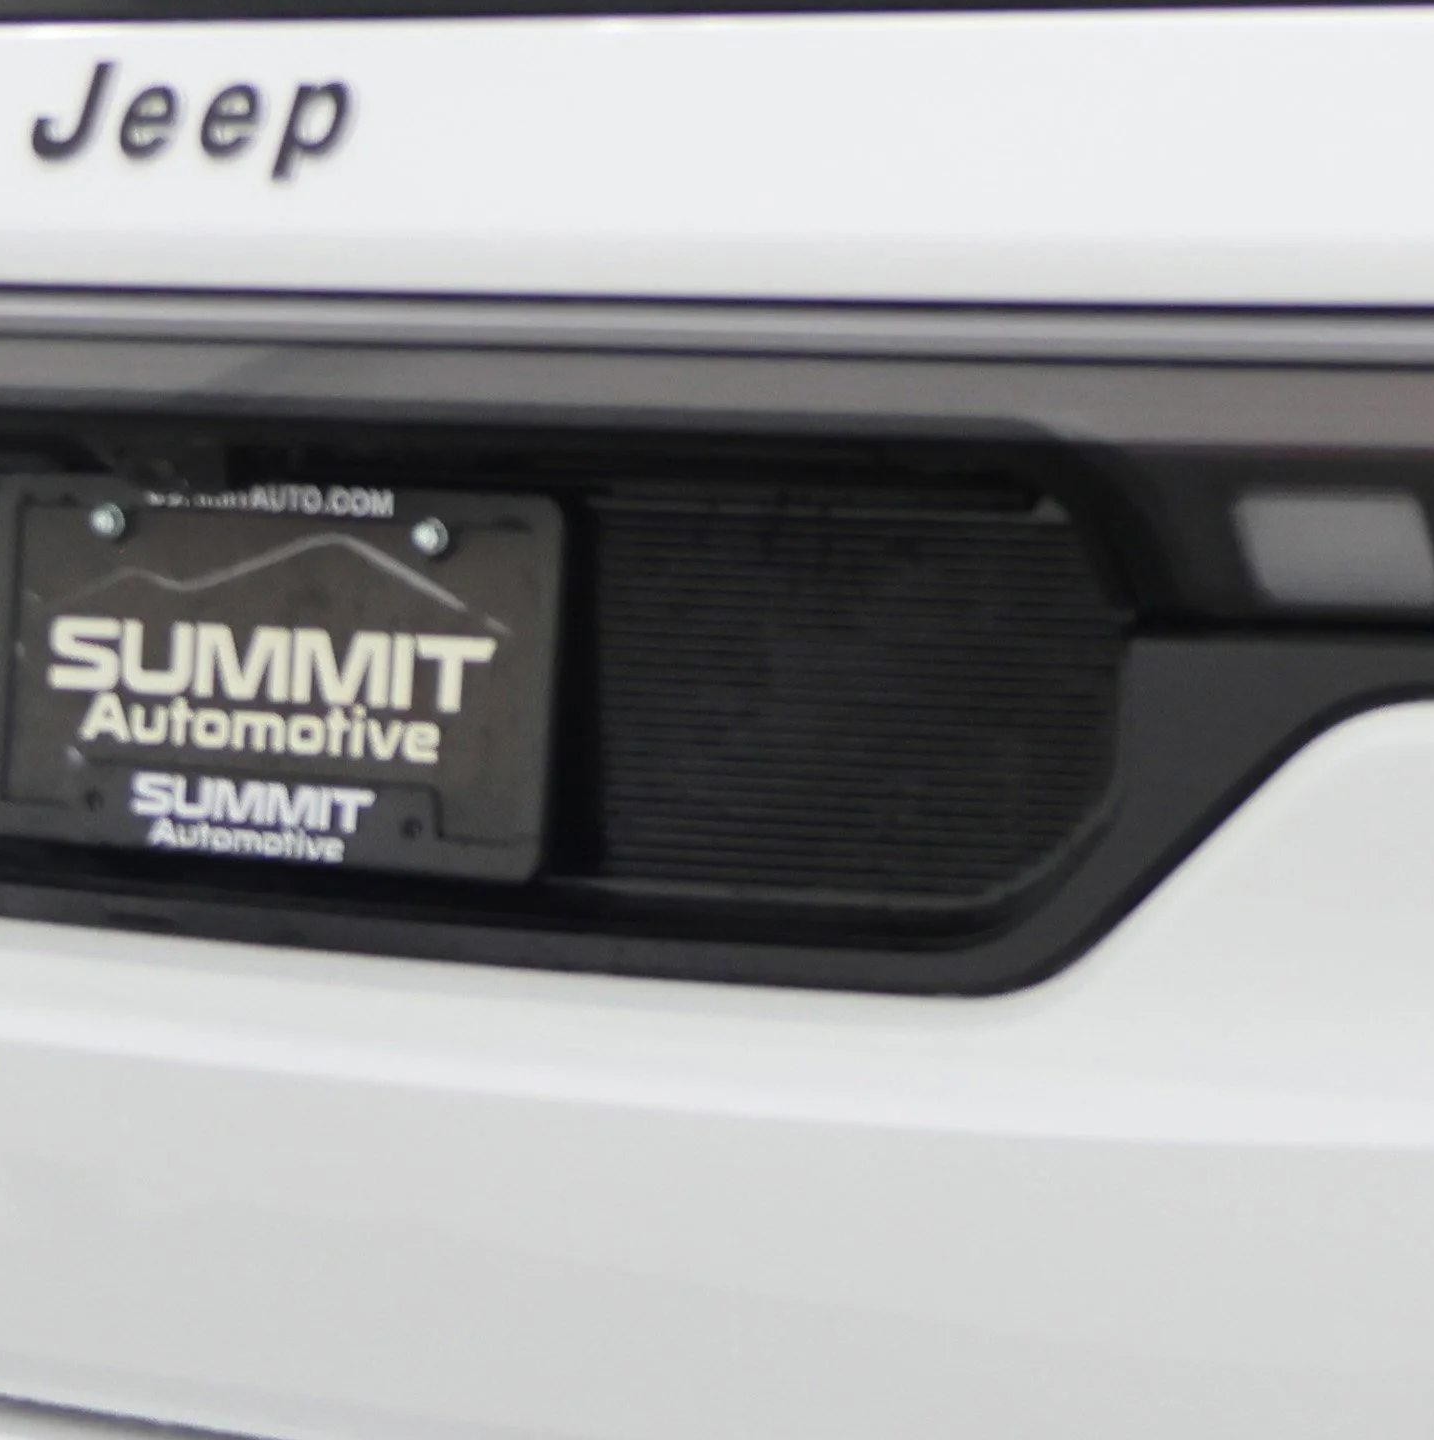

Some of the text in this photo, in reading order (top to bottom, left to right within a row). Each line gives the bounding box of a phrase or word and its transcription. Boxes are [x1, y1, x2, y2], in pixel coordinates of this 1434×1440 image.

[32, 61, 351, 180] Jeep
[48, 616, 497, 713] SUMMIT
[80, 692, 441, 764] Automotive
[130, 771, 376, 835] SUMMIT
[146, 818, 345, 863] Automotive
